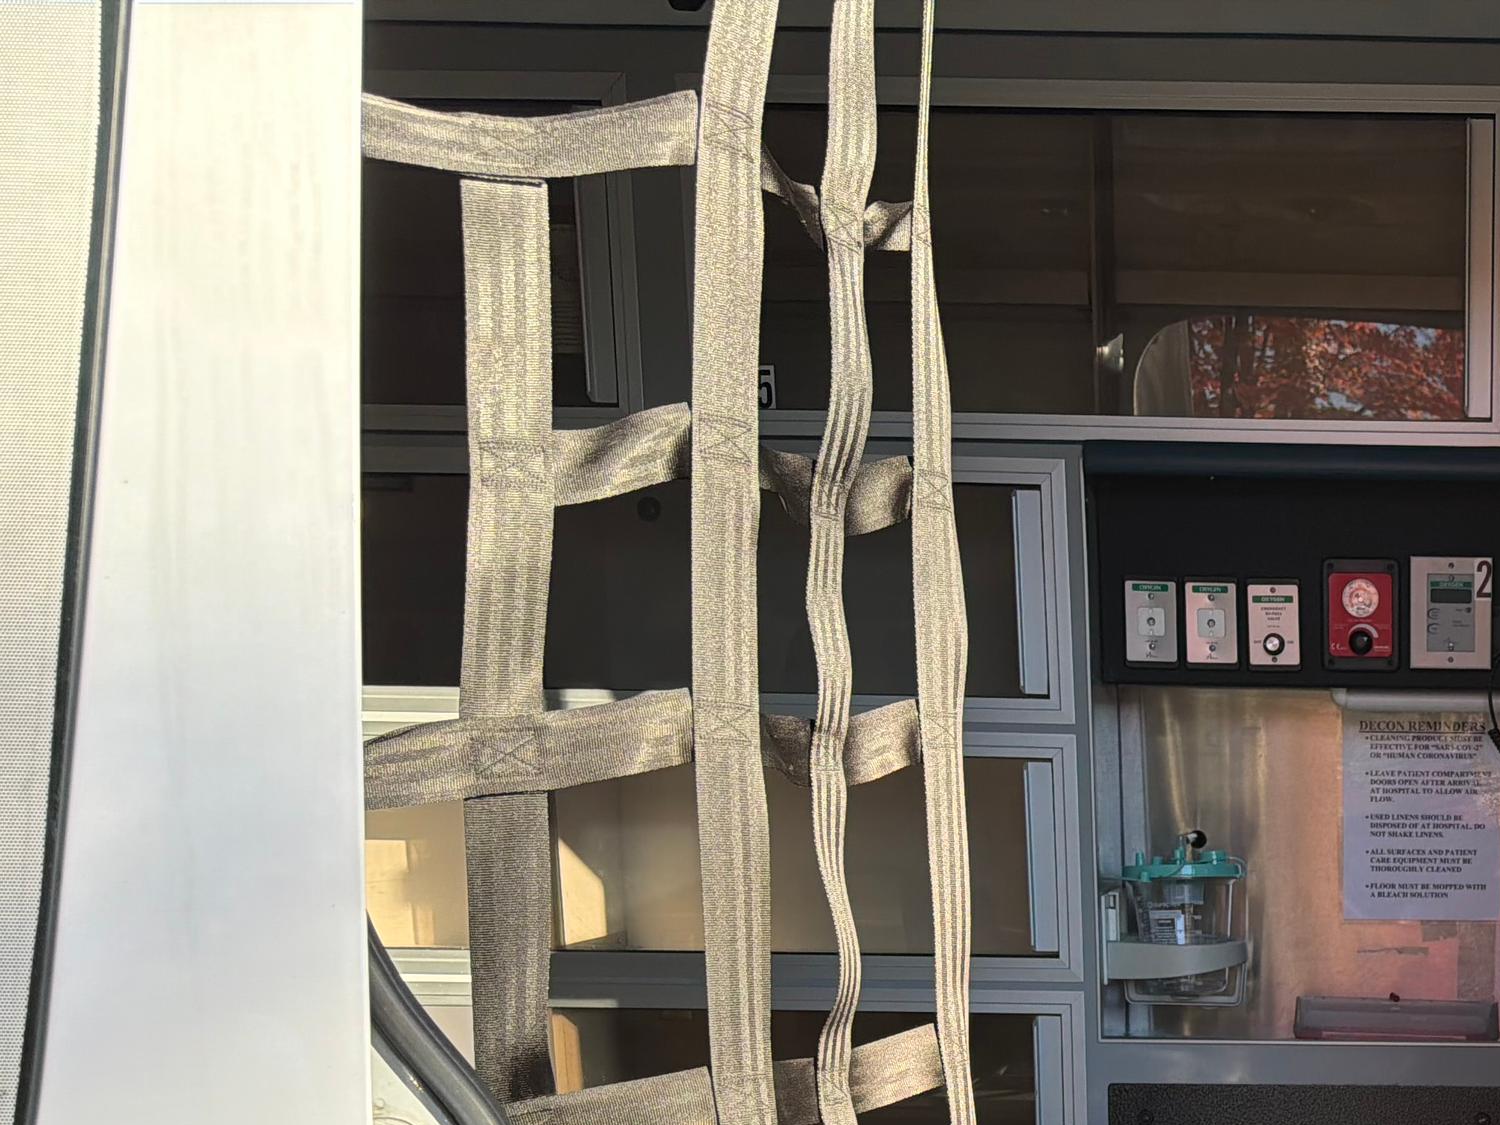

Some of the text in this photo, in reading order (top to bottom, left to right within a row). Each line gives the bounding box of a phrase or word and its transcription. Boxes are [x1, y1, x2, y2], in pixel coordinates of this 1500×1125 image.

[759, 370, 772, 408] 5
[1476, 560, 1492, 598] 2
[1360, 720, 1486, 732] DECON REMINDERS
[1392, 857, 1437, 865] EQUIPMENT
